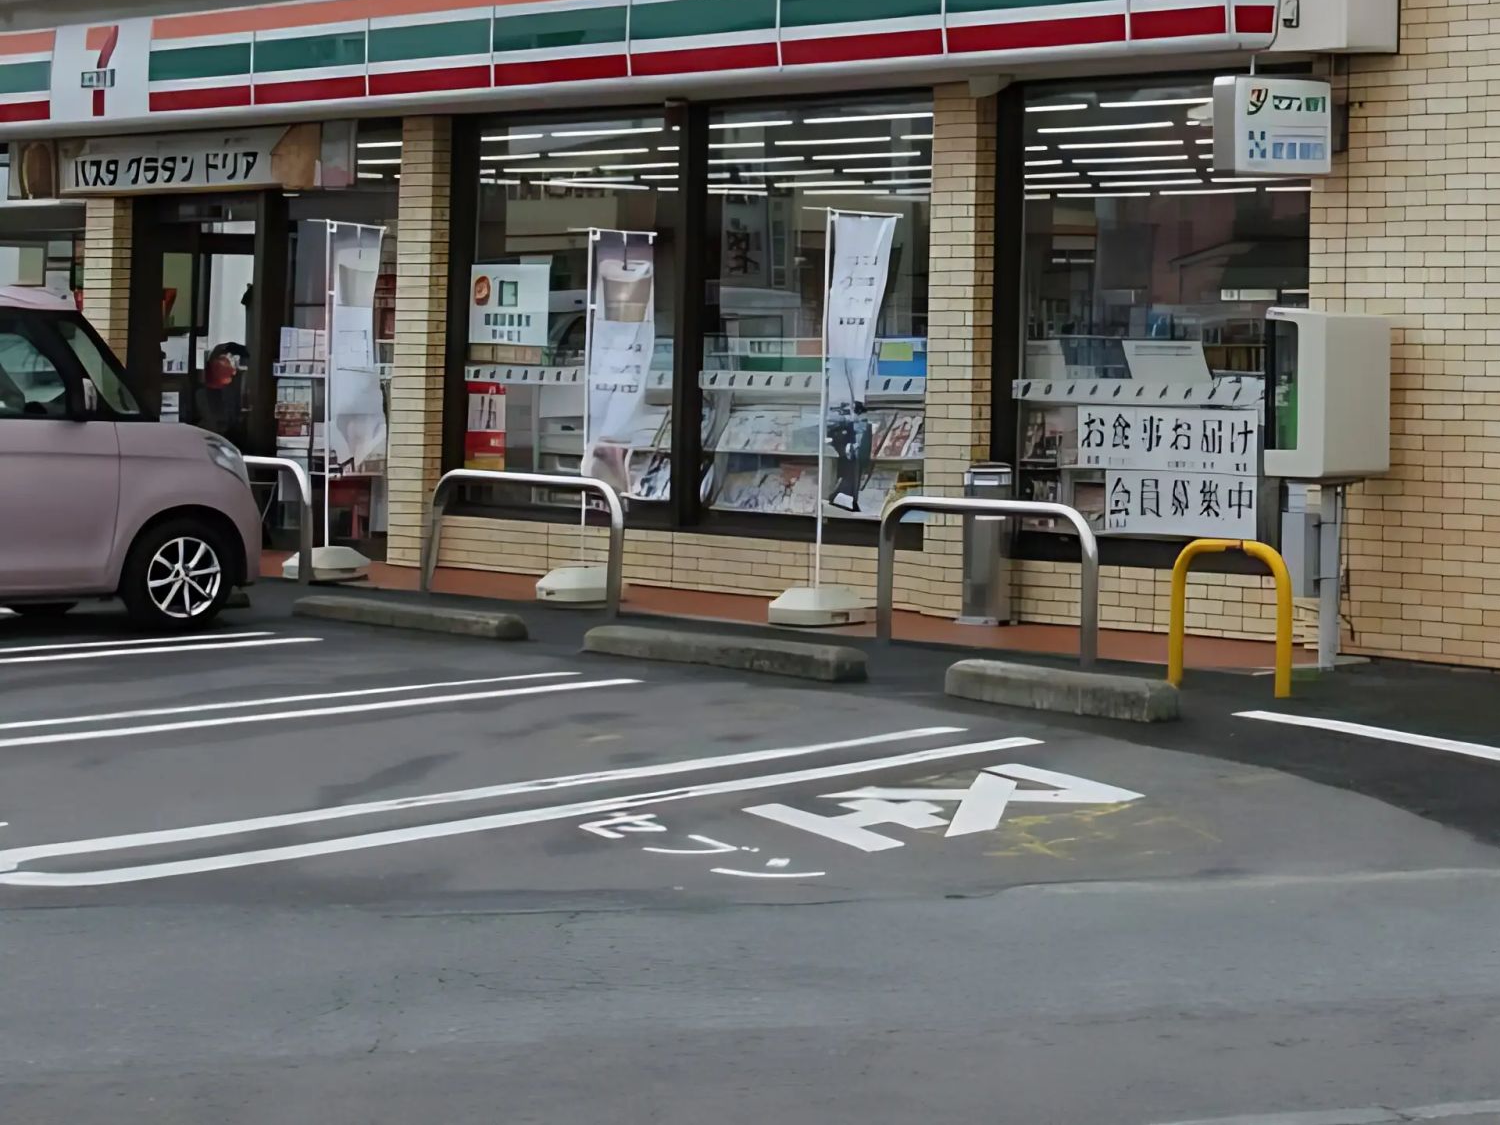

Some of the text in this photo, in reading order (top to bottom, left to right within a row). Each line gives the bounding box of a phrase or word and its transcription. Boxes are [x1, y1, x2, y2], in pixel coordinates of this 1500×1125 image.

[1081, 412, 1254, 456] お食事お届け
